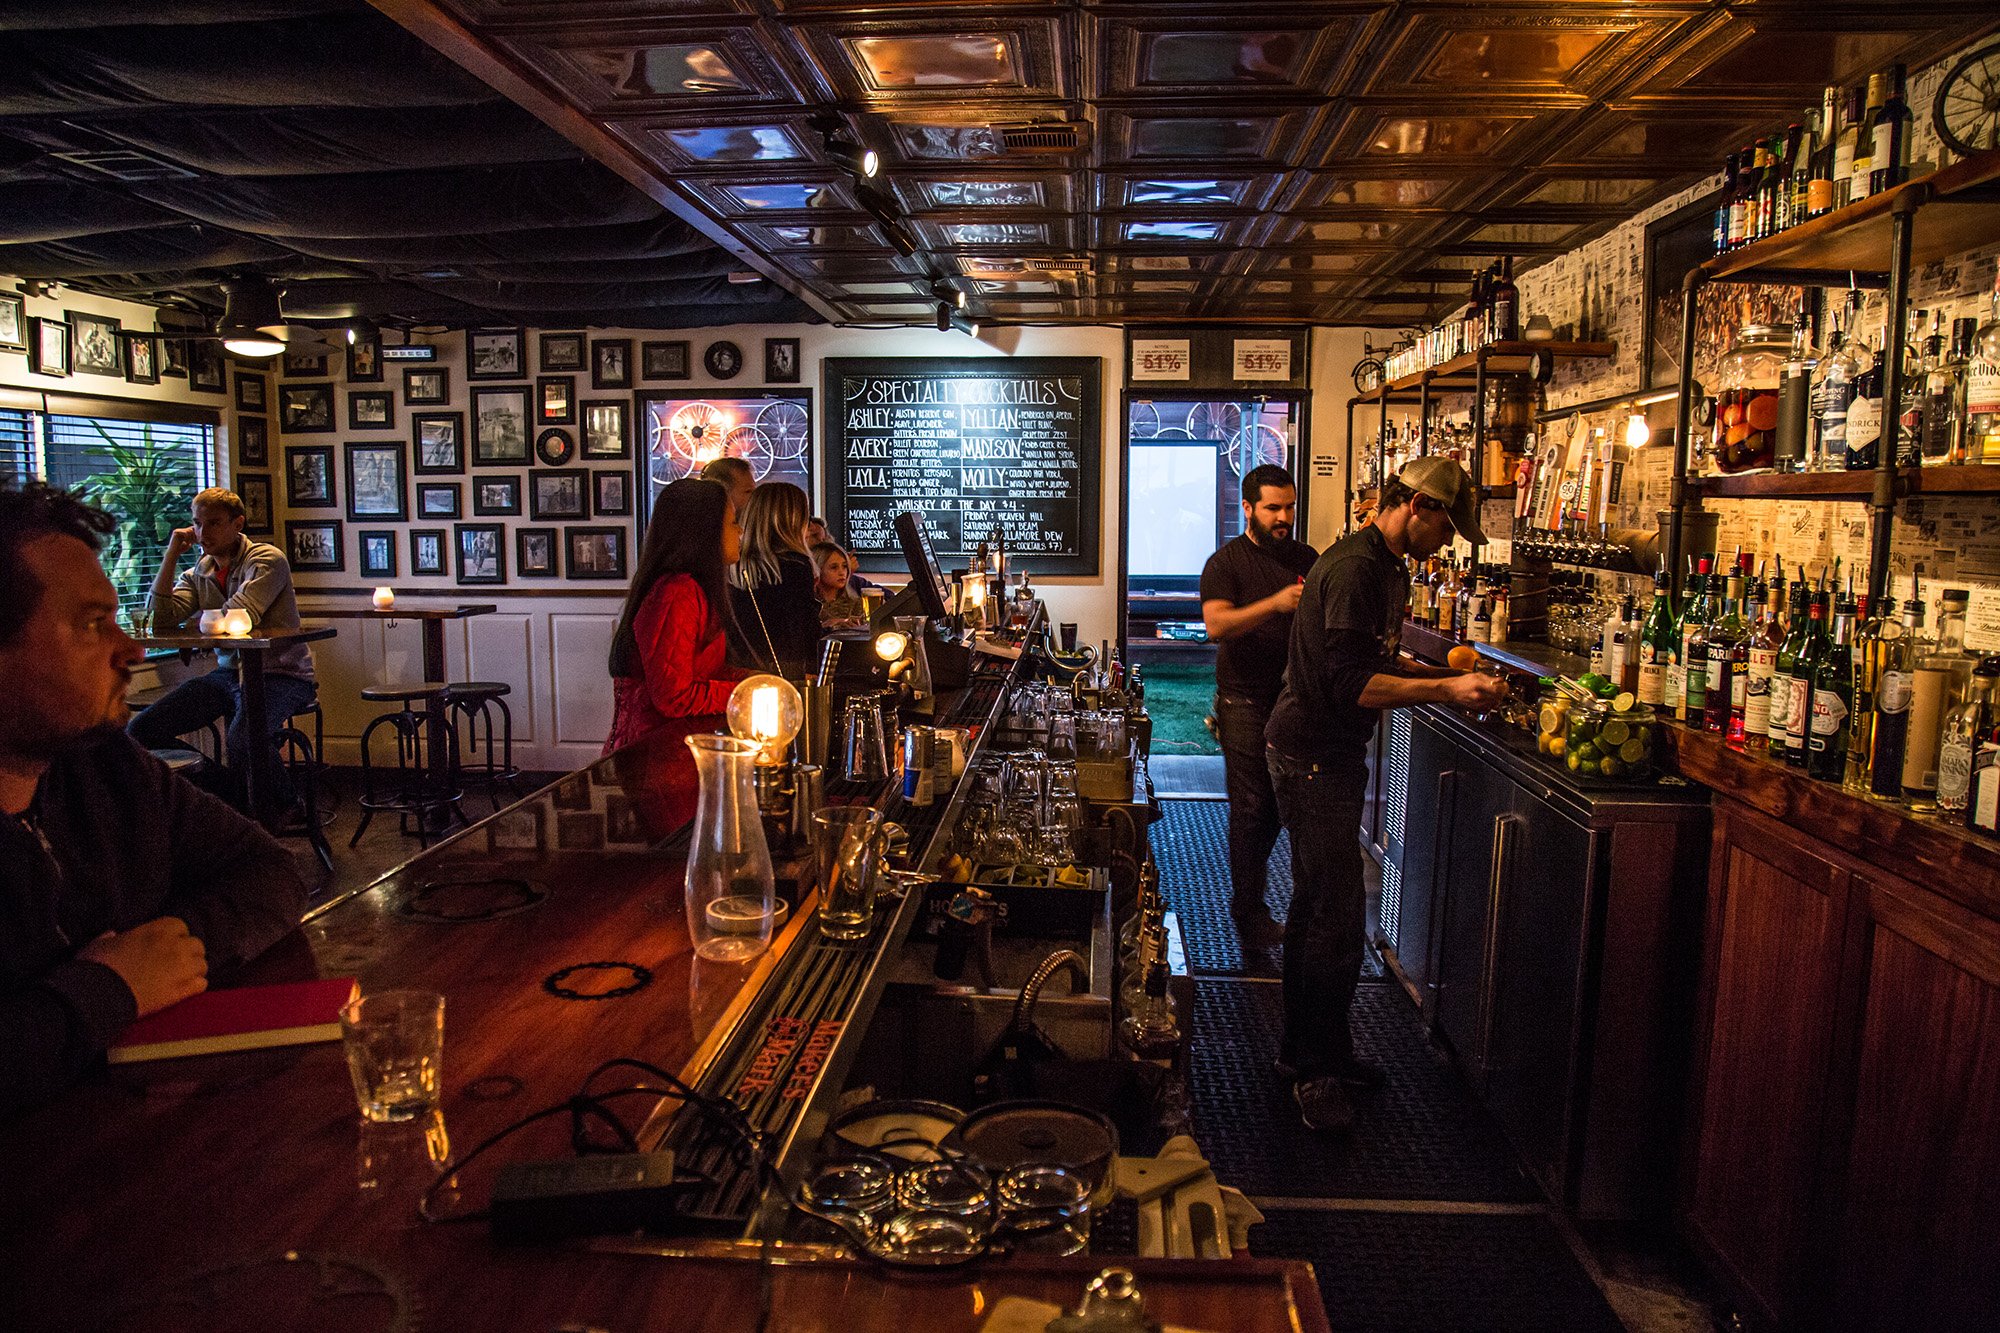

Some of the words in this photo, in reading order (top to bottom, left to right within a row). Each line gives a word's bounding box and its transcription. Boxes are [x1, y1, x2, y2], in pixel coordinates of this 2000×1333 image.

[1144, 354, 1181, 369] 51%
[1244, 354, 1282, 369] 51%
[867, 381, 960, 404] SPECIALTY
[969, 381, 1057, 405] COCKTAILS
[896, 500, 936, 510] WHISKEY
[941, 500, 953, 509] OF
[958, 500, 974, 510] THE
[980, 500, 997, 511] DAY
[1002, 500, 1017, 511] $4
[998, 512, 1025, 521] HEAVEN
[1030, 512, 1044, 521] HILL
[1001, 522, 1016, 531] JIM
[1018, 522, 1039, 531] BEAM
[929, 530, 950, 540] MARK
[1044, 531, 1064, 541] DEW
[1016, 541, 1047, 550] COCKTAILS
[1708, 647, 1729, 661] PARI
[1750, 653, 1776, 666] LET
[1732, 660, 1749, 673] ERO
